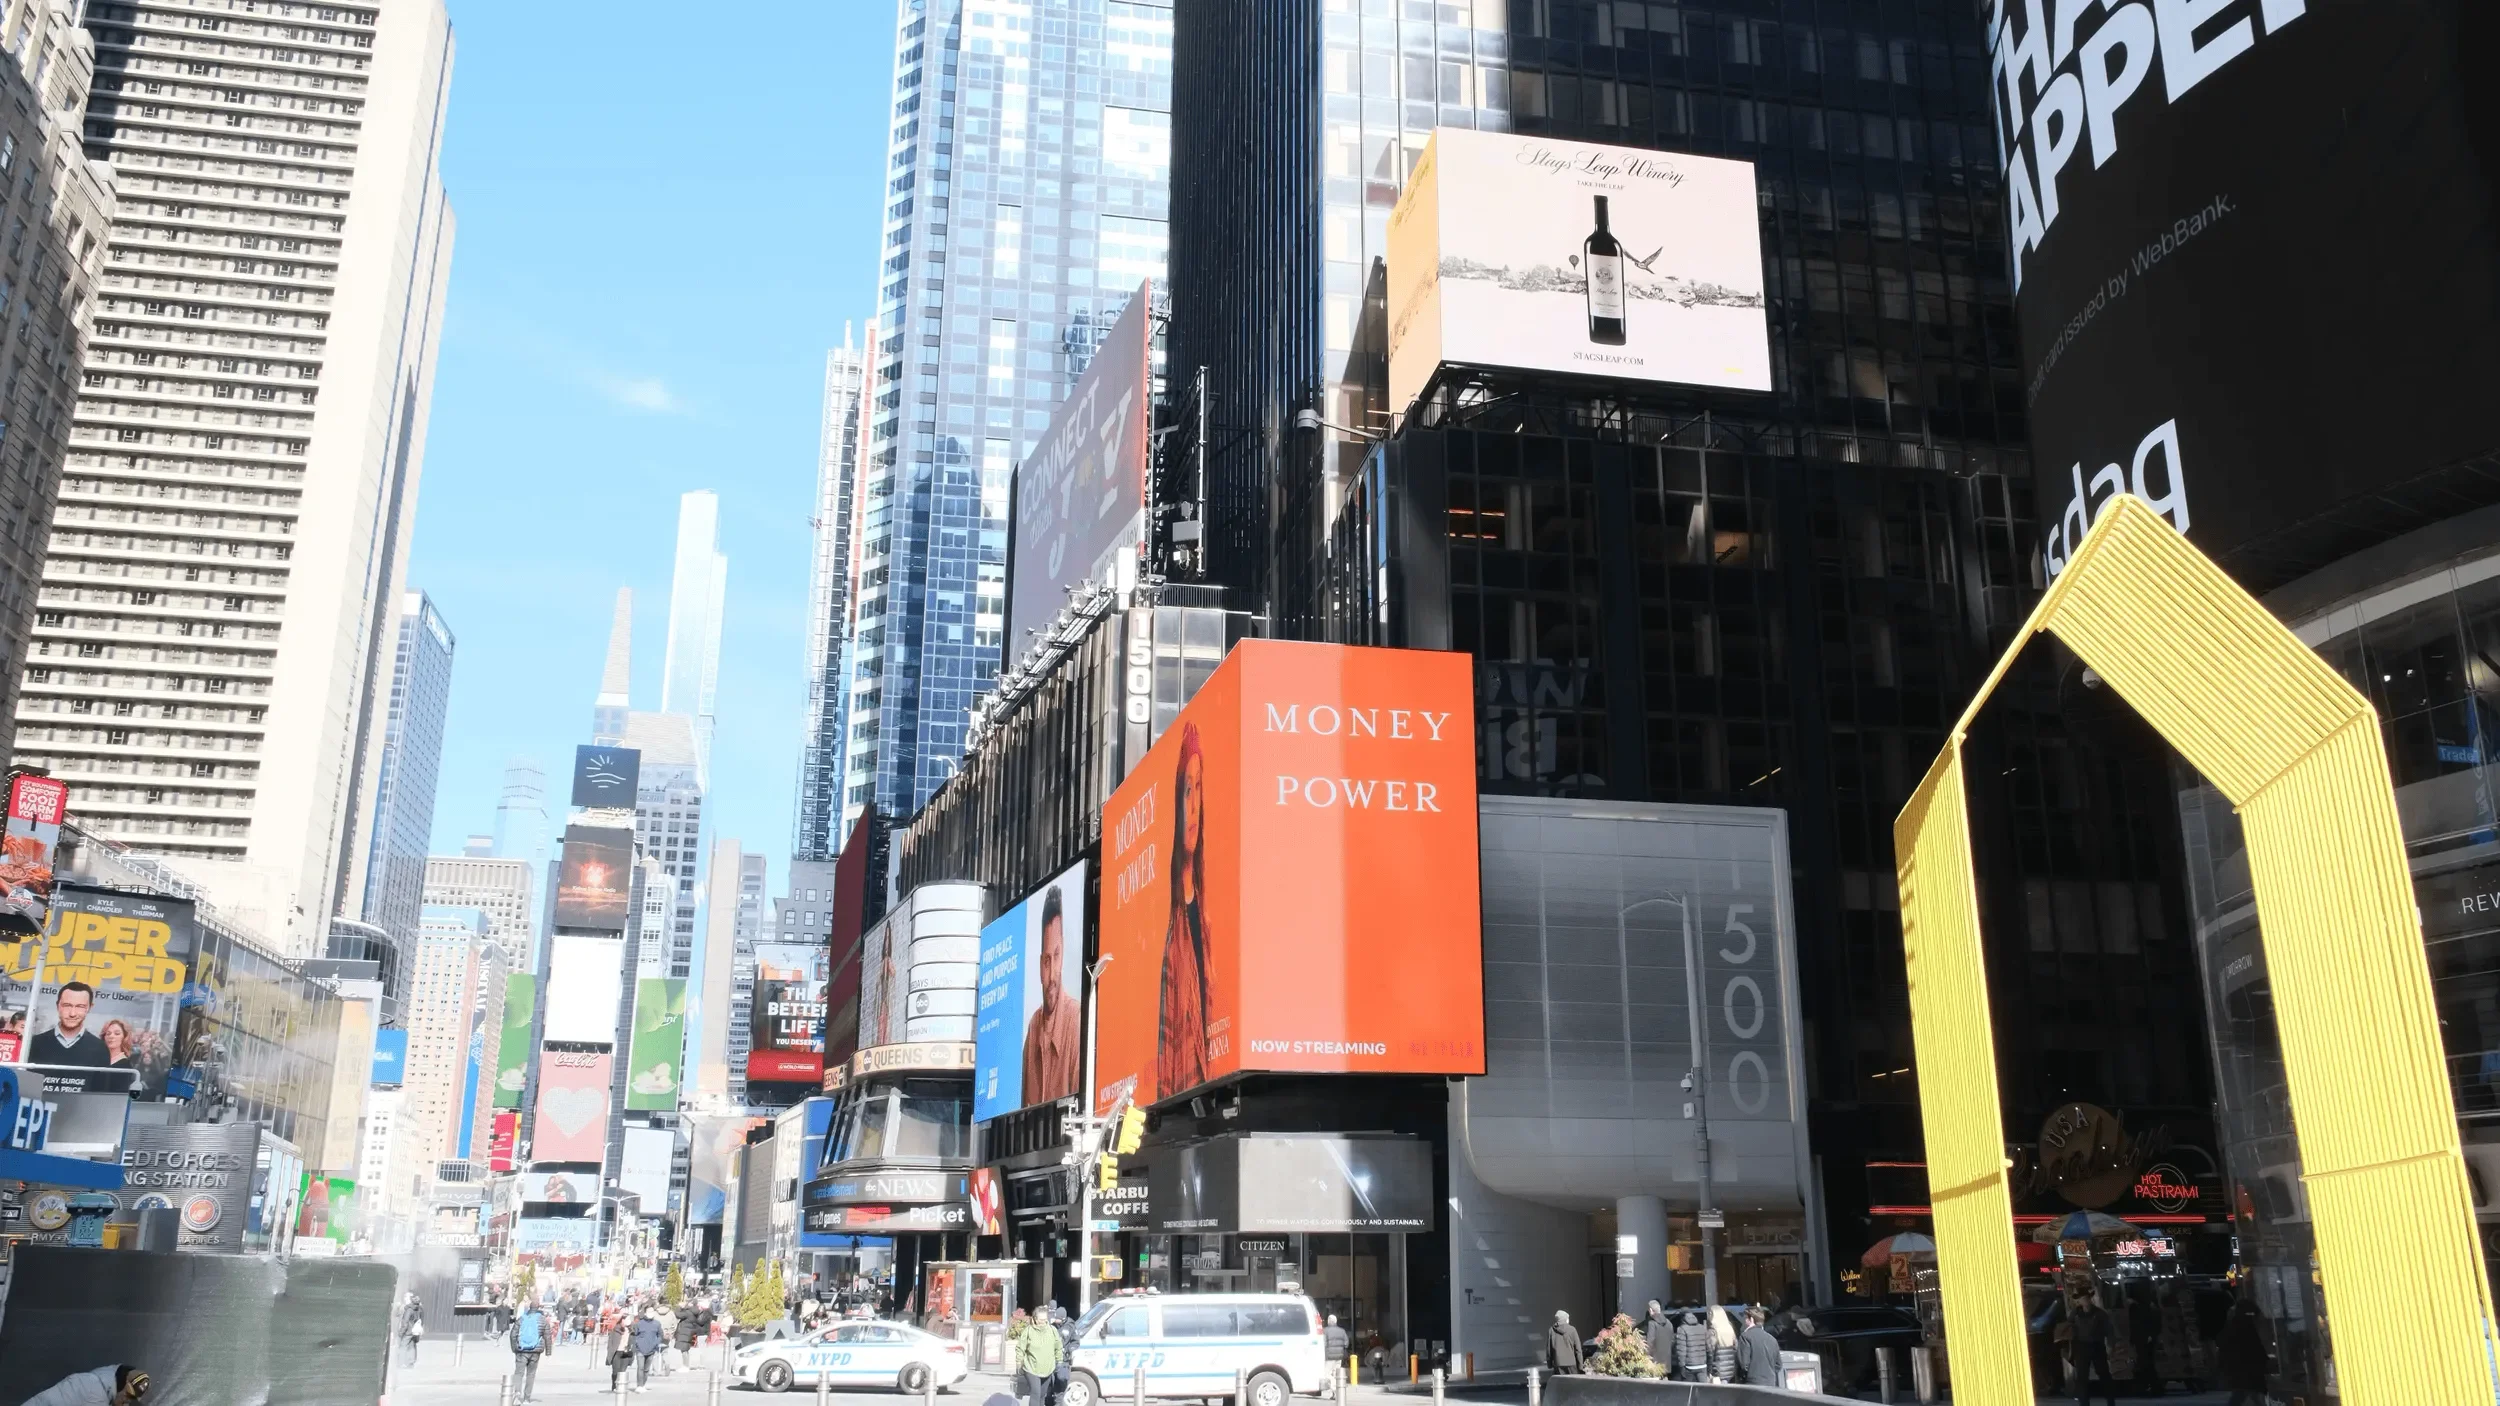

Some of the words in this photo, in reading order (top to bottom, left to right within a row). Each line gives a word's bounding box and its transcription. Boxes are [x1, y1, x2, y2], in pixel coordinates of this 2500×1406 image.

[1574, 150, 1622, 180] Leap
[1619, 154, 1690, 189] Winery
[2062, 283, 2106, 345] issued
[2108, 267, 2129, 300] by
[2131, 192, 2237, 277] WebBank.
[1021, 375, 1100, 525] CONNECT
[1126, 610, 1151, 724] 1500
[1263, 702, 1451, 742] MONEY
[19, 791, 58, 807] FOOD
[1275, 775, 1442, 813] POWER
[18, 801, 56, 817] WARM
[1114, 781, 1159, 861] MONEY
[1116, 842, 1157, 910] POWER
[86, 905, 123, 915] CHANDLER
[97, 899, 114, 907] KYLE
[141, 904, 157, 912] UMA
[132, 909, 165, 919] THURMAN
[21, 910, 172, 959] UPER
[9, 983, 27, 993] The
[94, 990, 111, 1000] For
[111, 992, 135, 1002] Uber
[780, 1019, 818, 1034] LIFE
[1207, 1033, 1230, 1062] ANNA
[1251, 1039, 1290, 1054] NOW
[1293, 1040, 1387, 1056] STREAMING
[874, 1047, 924, 1069] QUEENS
[61, 1077, 85, 1086] SURGE
[12, 1096, 58, 1150] EPT
[2045, 1104, 2090, 1149] USA
[155, 1151, 243, 1172] FORCES
[151, 1171, 229, 1187] STATION
[877, 1178, 937, 1197] NEWS
[2140, 1173, 2163, 1187] HOT
[2134, 1184, 2199, 1199] PASTRAMI
[824, 1212, 841, 1228] games
[909, 1207, 966, 1223] Picket
[1103, 1202, 1149, 1216] COFFE
[1369, 1218, 1382, 1226] AND
[1384, 1218, 1425, 1227] SUSTAINABLY.
[1240, 1240, 1285, 1251] CITIZEN
[807, 1351, 852, 1367] NYPD
[1104, 1352, 1167, 1370] NYPD
